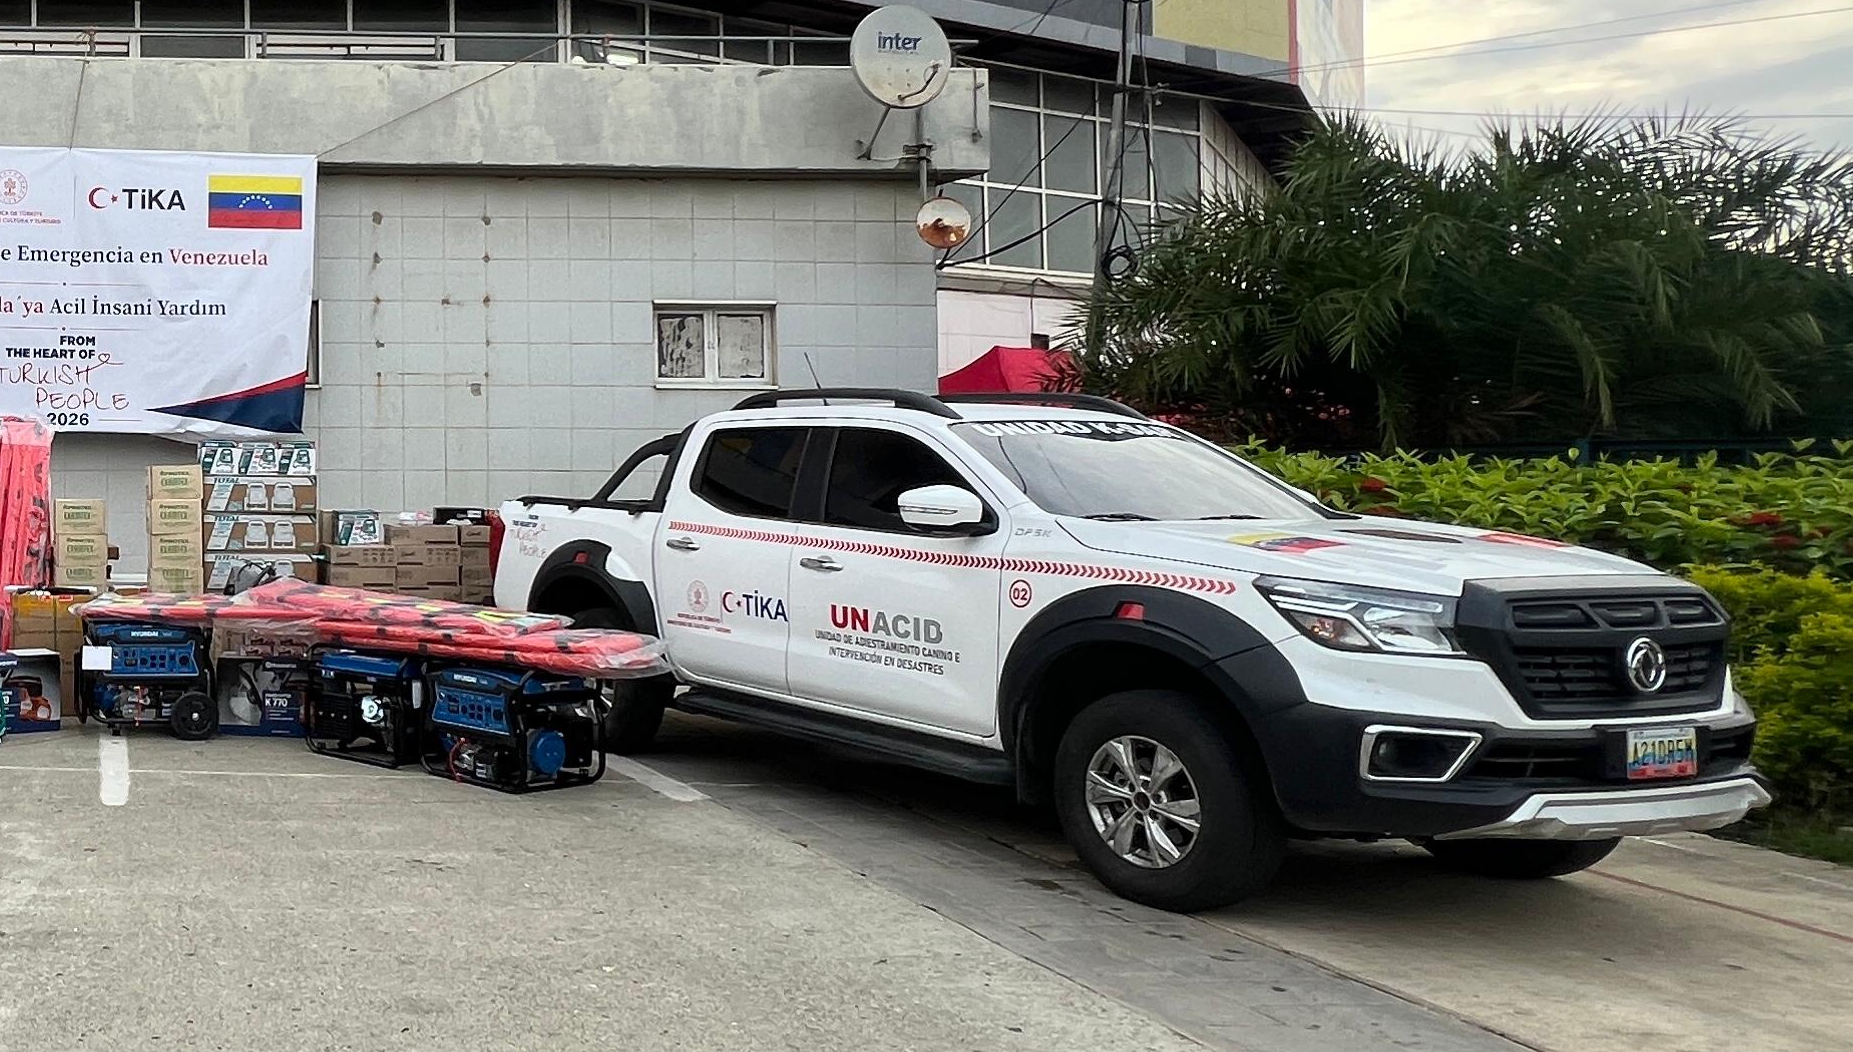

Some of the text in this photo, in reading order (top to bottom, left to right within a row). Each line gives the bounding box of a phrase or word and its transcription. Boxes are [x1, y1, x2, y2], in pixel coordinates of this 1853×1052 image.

[877, 31, 922, 51] inter
[17, 245, 134, 268] Emergencia
[139, 250, 163, 264] en
[169, 248, 269, 266] Venezuela
[49, 298, 85, 315] Acil
[92, 294, 152, 316] İnsani
[157, 298, 226, 316] Yardım
[59, 335, 96, 346] FROM
[5, 347, 96, 360] THE HEART OF
[36, 387, 130, 410] PEOPLE
[46, 412, 90, 426] 2026
[970, 422, 1092, 437] UNIDAD
[1014, 528, 1053, 537] DFSK
[1012, 587, 1028, 601] 02
[830, 603, 943, 645] UNACID
[815, 629, 961, 663] UNIDAD DE ADIESTRAMIENTO CANINO E
[883, 655, 895, 667] EN
[897, 658, 944, 676] DESASTRES
[265, 698, 288, 707] K 770
